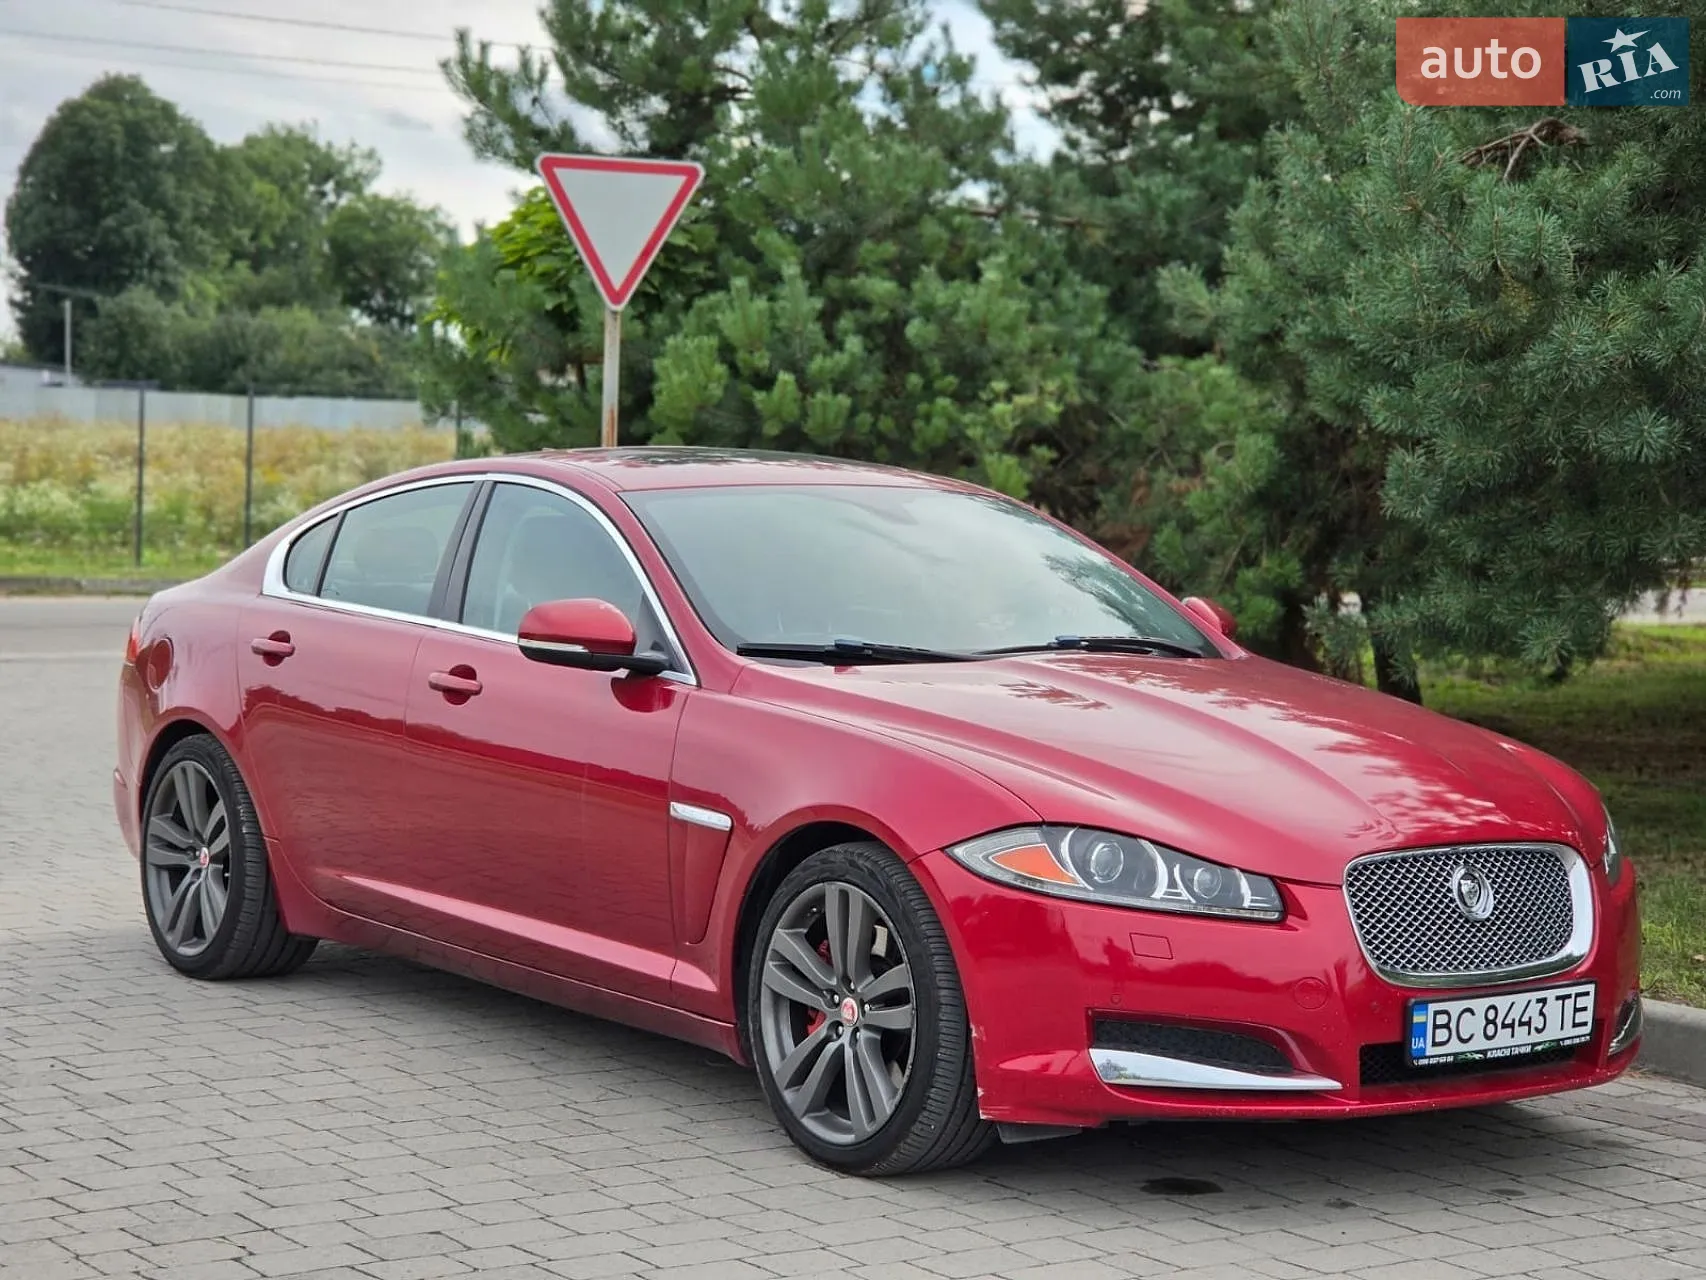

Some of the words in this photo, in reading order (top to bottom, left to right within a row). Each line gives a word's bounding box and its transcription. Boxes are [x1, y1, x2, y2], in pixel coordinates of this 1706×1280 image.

[1431, 1007, 1476, 1048] BC
[1482, 997, 1548, 1041] 8443
[1555, 990, 1592, 1031] TE
[1411, 1037, 1425, 1050] UA
